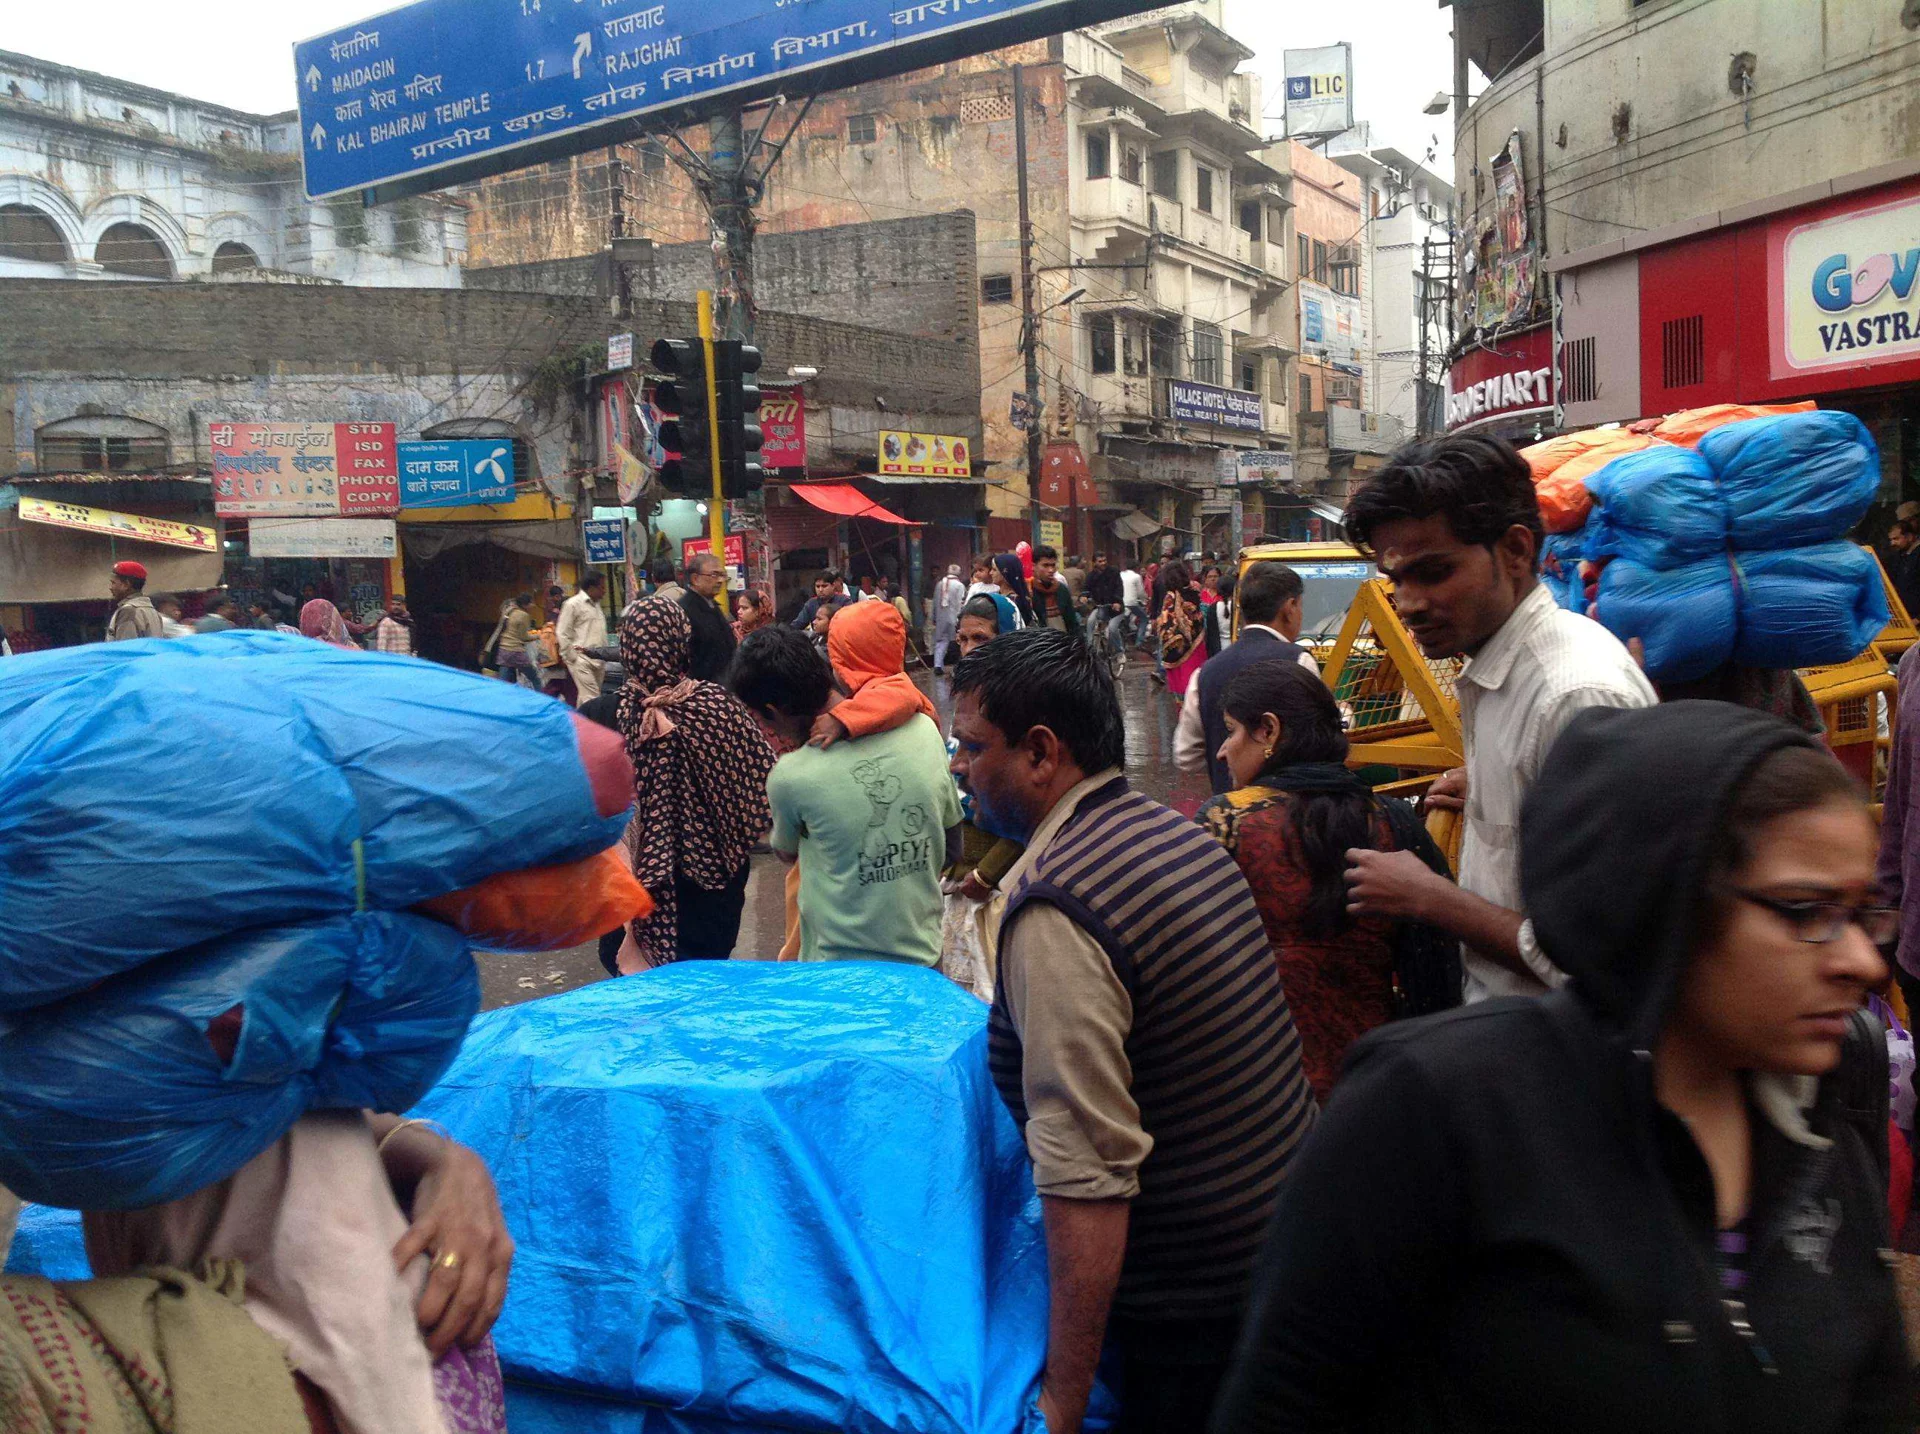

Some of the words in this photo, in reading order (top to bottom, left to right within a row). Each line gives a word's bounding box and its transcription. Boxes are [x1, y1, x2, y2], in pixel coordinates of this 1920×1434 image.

[604, 5, 665, 38] राजघाट
[329, 31, 379, 63] मैदागिन
[605, 35, 683, 75] RAJGHAT
[332, 58, 395, 94] MAIDAGIN
[525, 59, 545, 81] 1.7
[1314, 75, 1343, 95] LIC
[335, 100, 363, 122] काल
[411, 126, 491, 160] प्रान्तीय
[583, 82, 647, 111] लोक
[661, 52, 756, 90] निर्माण
[336, 132, 364, 153] KAL
[370, 112, 426, 145] BHAIRAV
[434, 92, 491, 125] TEMPLE
[1174, 386, 1202, 406] PALACE
[1203, 391, 1226, 410] HOTEL
[212, 425, 235, 447] दी
[249, 425, 333, 450] मोबाईल
[349, 424, 382, 435] STD
[355, 441, 384, 451] ISD
[354, 458, 386, 468] FAX
[405, 461, 431, 475] दाम
[434, 460, 459, 473] कम
[340, 475, 397, 486] PHOTO
[315, 502, 336, 510] BSNL
[346, 492, 393, 503] COPY
[342, 505, 399, 514] LAMINATION
